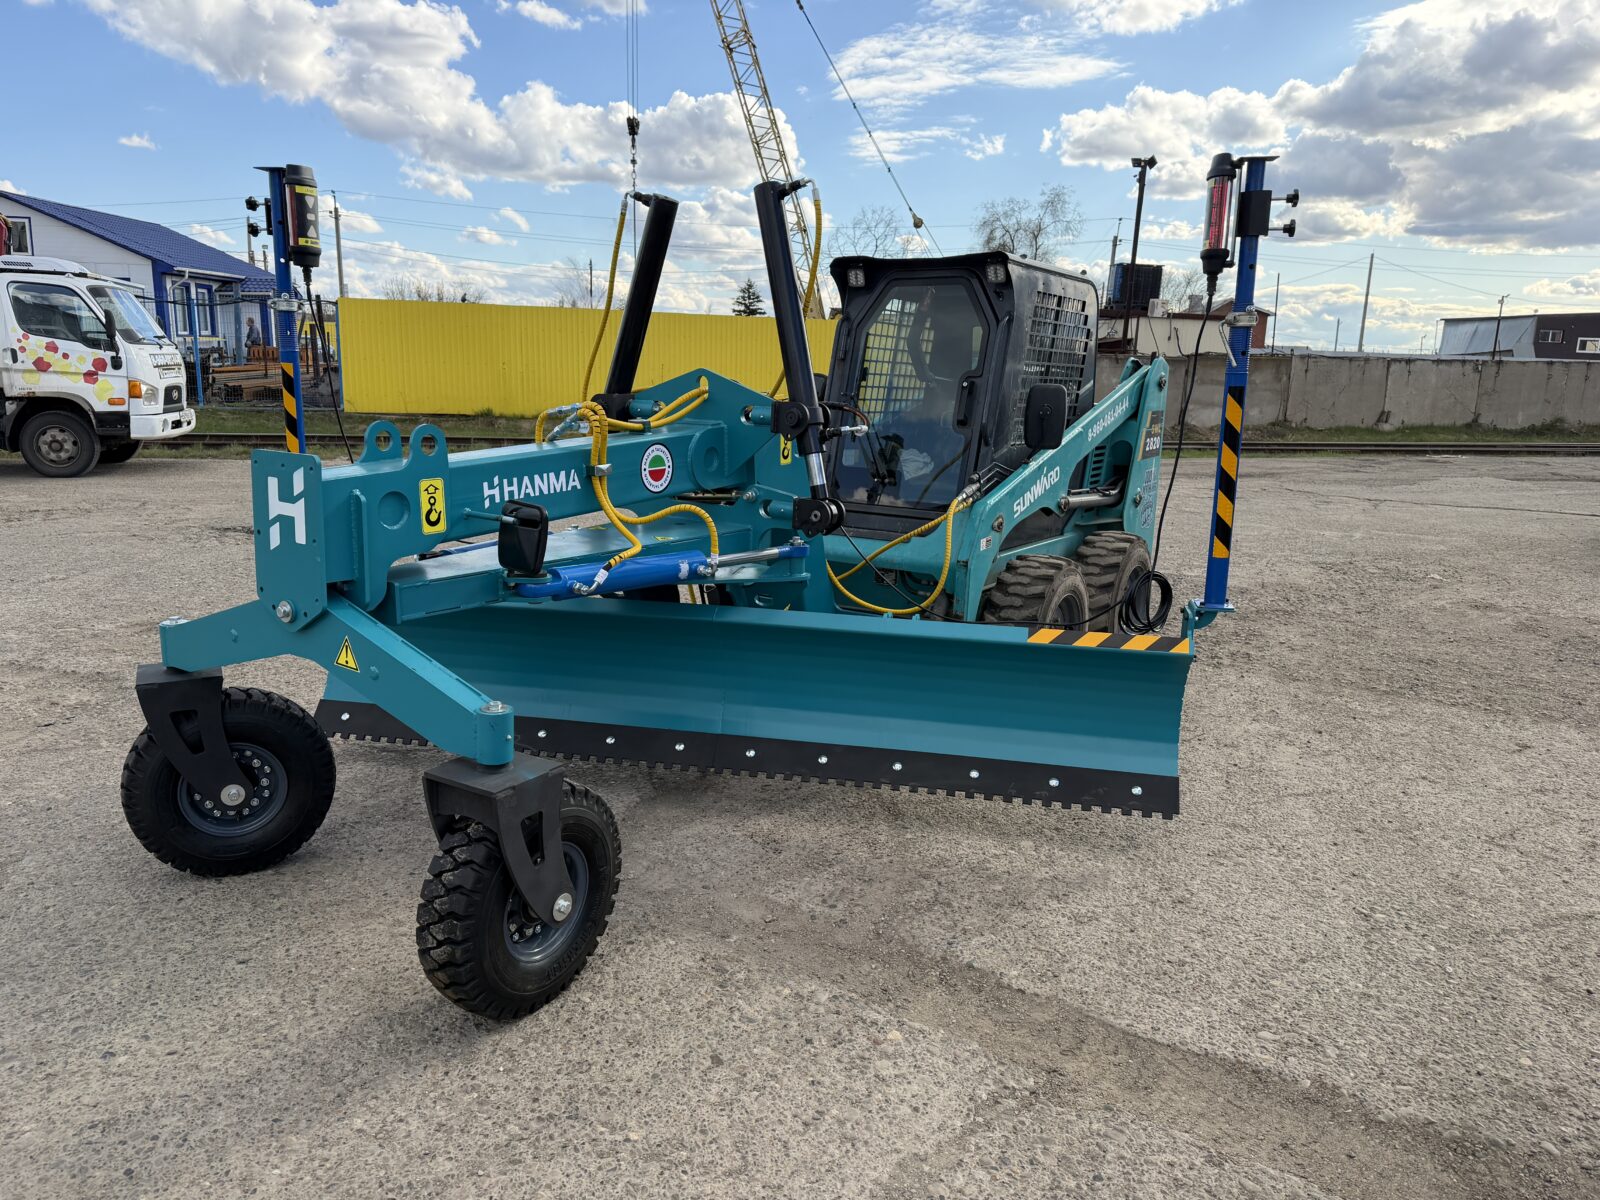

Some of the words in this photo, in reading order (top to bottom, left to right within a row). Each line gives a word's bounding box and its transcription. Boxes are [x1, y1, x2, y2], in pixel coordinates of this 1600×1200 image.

[1145, 436, 1160, 452] 2820
[502, 469, 582, 501] HANMA
[1013, 466, 1060, 519] SUNWARD
